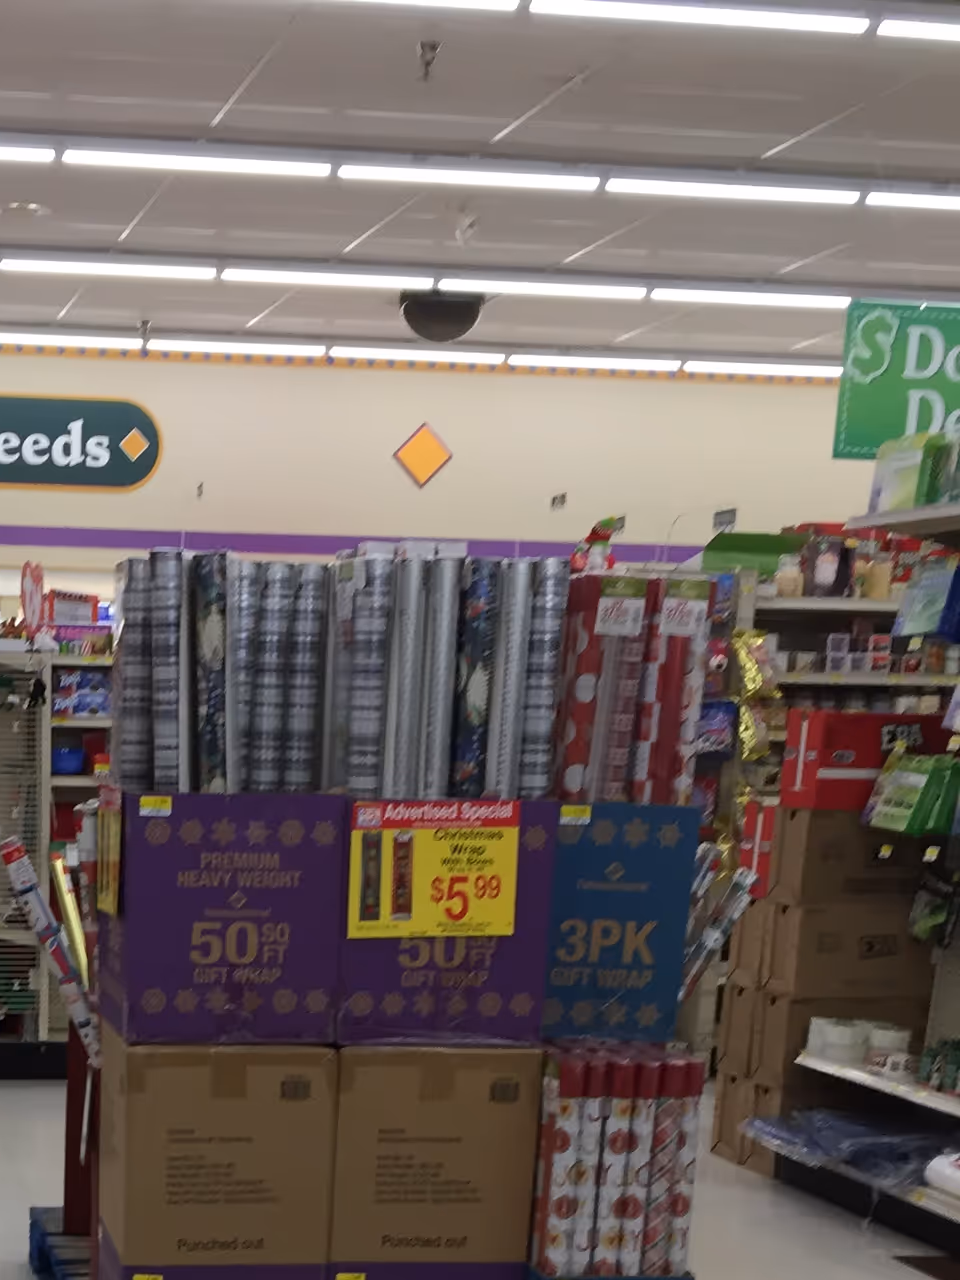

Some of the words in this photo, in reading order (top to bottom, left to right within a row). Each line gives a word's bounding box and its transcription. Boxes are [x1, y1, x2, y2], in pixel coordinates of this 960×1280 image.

[384, 802, 458, 820] Advertised
[460, 800, 514, 822] Special
[433, 828, 504, 842] Christmas
[449, 843, 488, 857] Wrap
[200, 852, 280, 869] PREMIUM
[177, 871, 231, 888] HEAVY
[237, 870, 302, 888] WEIGHT
[190, 921, 259, 965] 50
[556, 918, 658, 965] 3PK
[263, 944, 289, 963] FT
[398, 936, 467, 970] 50
[193, 967, 228, 984] GIFT
[401, 970, 436, 988] GIFT
[440, 969, 489, 988] WRAP
[550, 968, 590, 987] GIFT
[596, 968, 655, 989] WRAP
[177, 1236, 238, 1252] Punched
[241, 1236, 265, 1250] out
[381, 1233, 441, 1249] Punched
[444, 1234, 468, 1249] out
